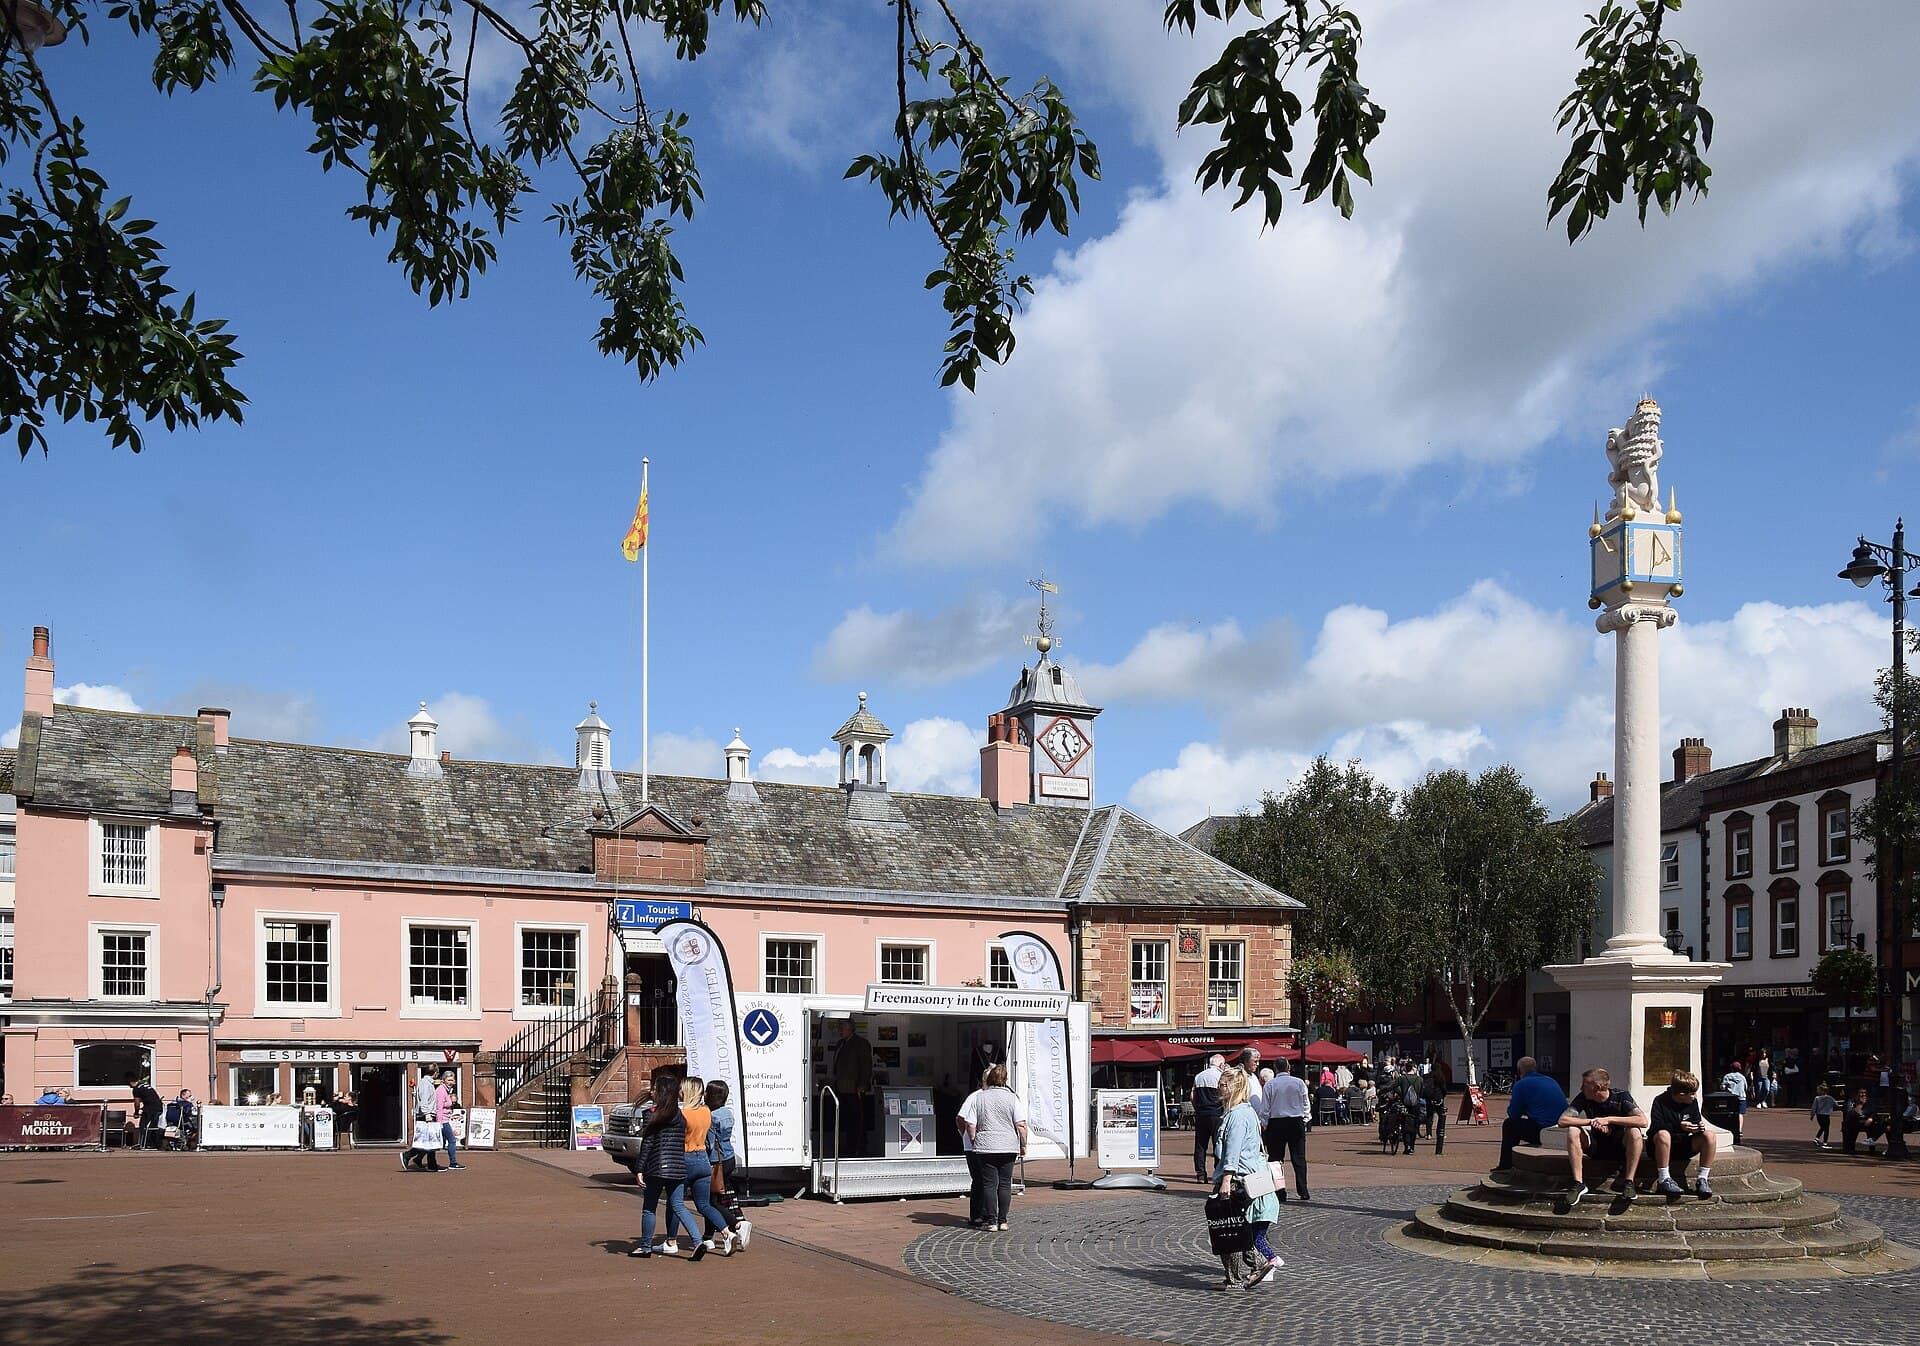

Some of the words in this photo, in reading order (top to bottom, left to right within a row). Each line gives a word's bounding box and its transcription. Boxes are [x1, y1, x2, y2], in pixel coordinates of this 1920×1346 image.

[648, 904, 679, 914] Tourist
[873, 991, 954, 1009] Freemasonry
[957, 994, 967, 1006] in
[972, 994, 990, 1007] the
[993, 995, 1063, 1012] Community
[384, 1050, 420, 1060] HUB
[762, 1082, 788, 1091] England
[21, 1125, 73, 1136] MORETTI
